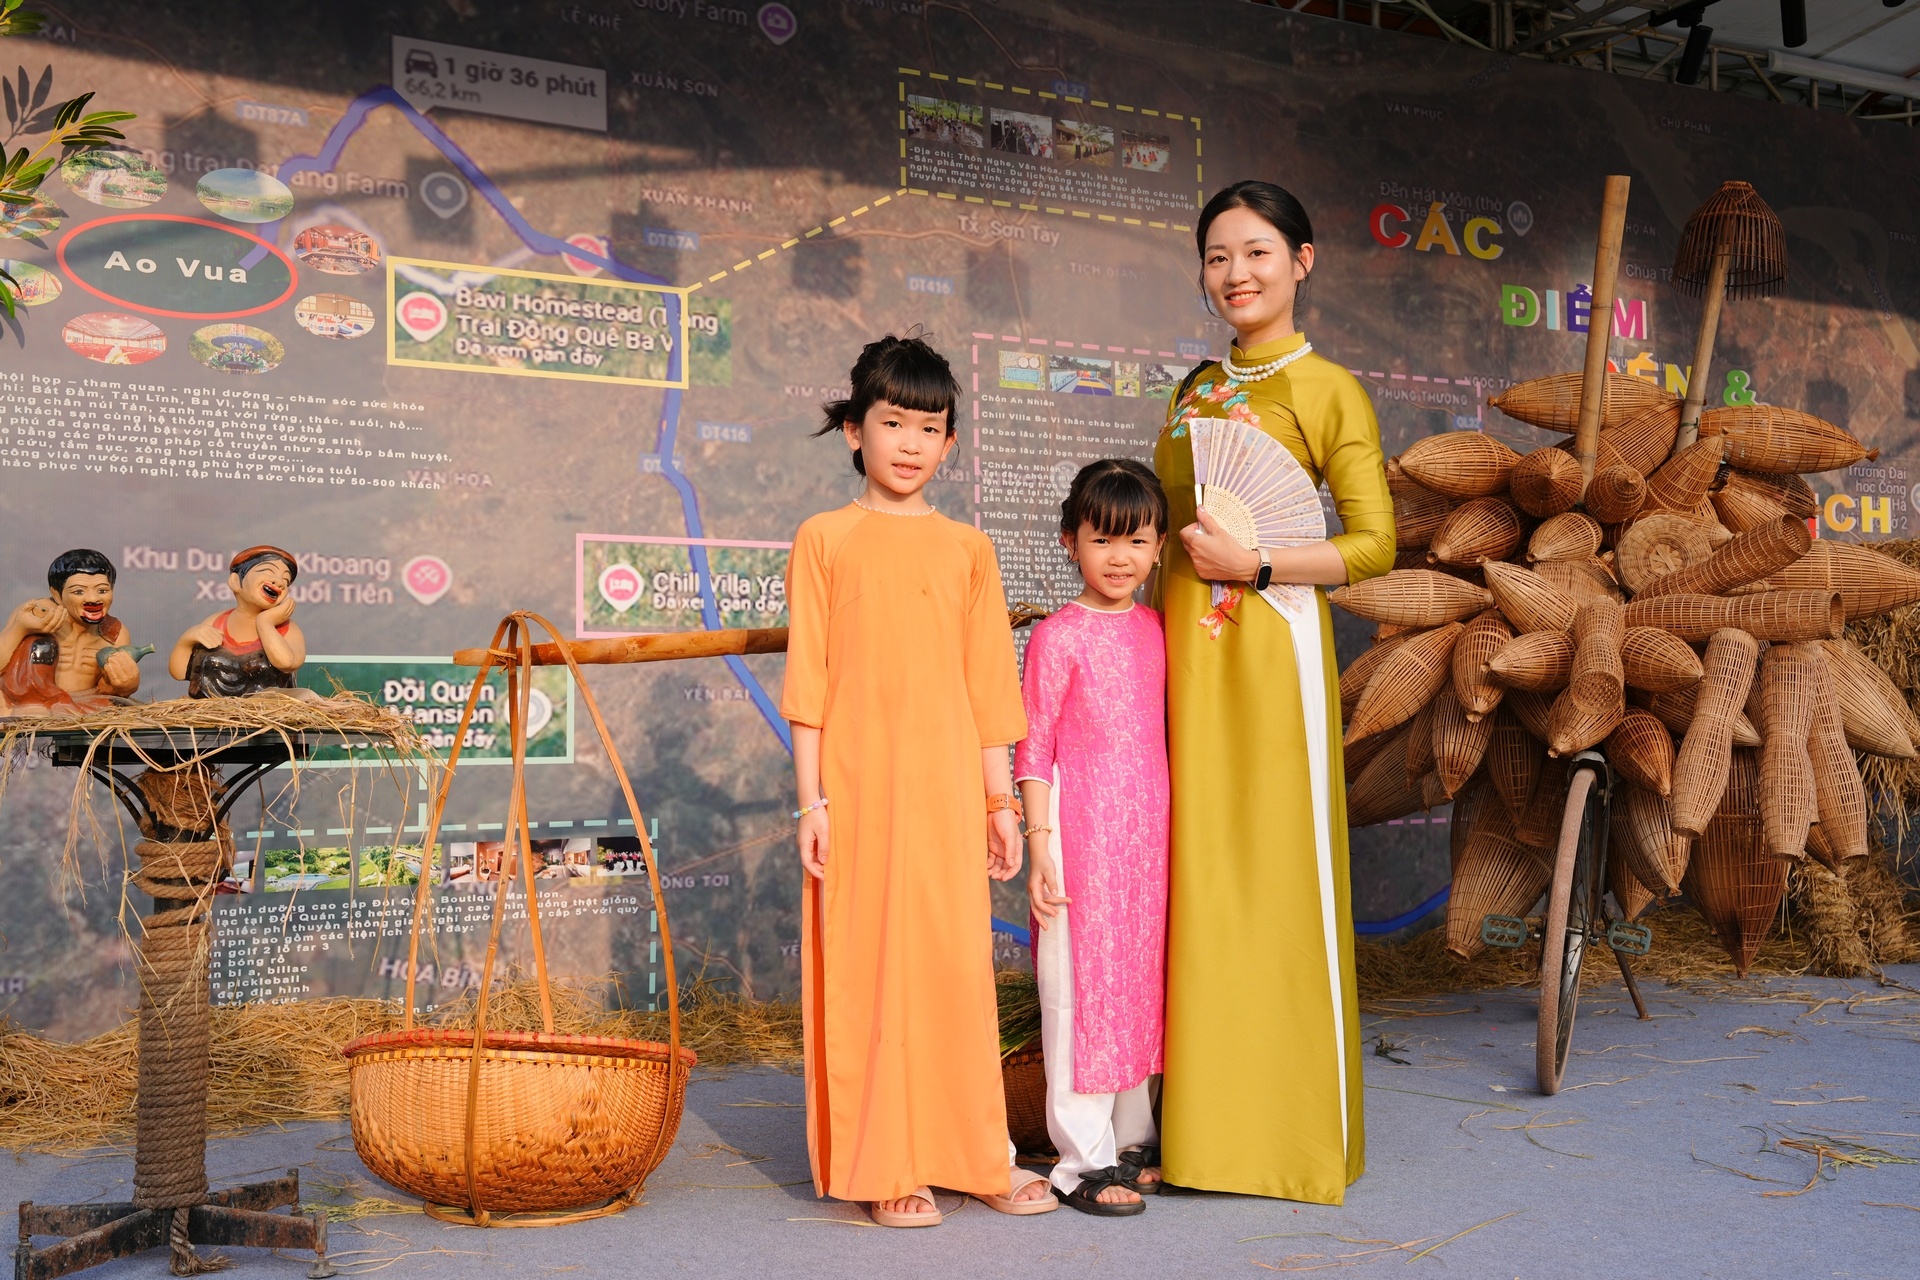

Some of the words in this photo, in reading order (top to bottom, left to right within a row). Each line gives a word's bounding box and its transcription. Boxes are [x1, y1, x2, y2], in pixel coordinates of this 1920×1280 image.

[694, 1, 748, 27] Farm
[444, 57, 455, 75] 1
[466, 61, 504, 85] giờ
[510, 68, 538, 88] 36
[546, 74, 598, 97] phút
[405, 78, 447, 100] 66,2
[450, 84, 481, 103] km
[1065, 169, 1079, 177] Ba
[990, 220, 1025, 241] Sơn
[1030, 224, 1062, 248] Tây
[1370, 201, 1505, 260] CÁC
[104, 250, 158, 275] Ao
[176, 256, 248, 285] Vua
[456, 285, 507, 311] Bavi
[513, 293, 643, 325] Homestead
[505, 317, 570, 348] Đồng
[574, 325, 620, 349] Quê
[625, 330, 655, 352] Ba
[486, 343, 528, 360] xem
[569, 347, 603, 368] đây
[33, 384, 59, 394] Bát
[191, 396, 209, 405] Ba
[242, 399, 259, 409] Hà
[267, 401, 289, 413] Nội
[84, 378, 120, 389] tham
[128, 383, 165, 392] quan
[333, 396, 356, 406] sóc
[1010, 396, 1023, 404] An
[1723, 369, 1758, 406] &
[981, 411, 1005, 419] Chill
[1009, 413, 1031, 421] Villa
[702, 425, 748, 441] DT416
[110, 463, 133, 474] hội
[351, 476, 395, 486] 50-500
[401, 478, 440, 489] khách
[983, 510, 1018, 520] THÔNG
[122, 545, 180, 571] Khu
[187, 548, 224, 572] Du
[298, 552, 392, 579] Khoang
[338, 584, 395, 605] Tiên
[653, 571, 700, 594] Chill
[710, 572, 751, 595] Villa
[757, 574, 786, 596] Yê
[384, 675, 426, 703] Đồi
[617, 907, 638, 915] quy
[228, 946, 258, 957] golf
[263, 946, 270, 954] 2
[296, 944, 316, 952] far
[322, 943, 329, 951] 3
[228, 957, 264, 967] bóng
[227, 974, 300, 988] pickleball
[267, 965, 308, 974] billac
